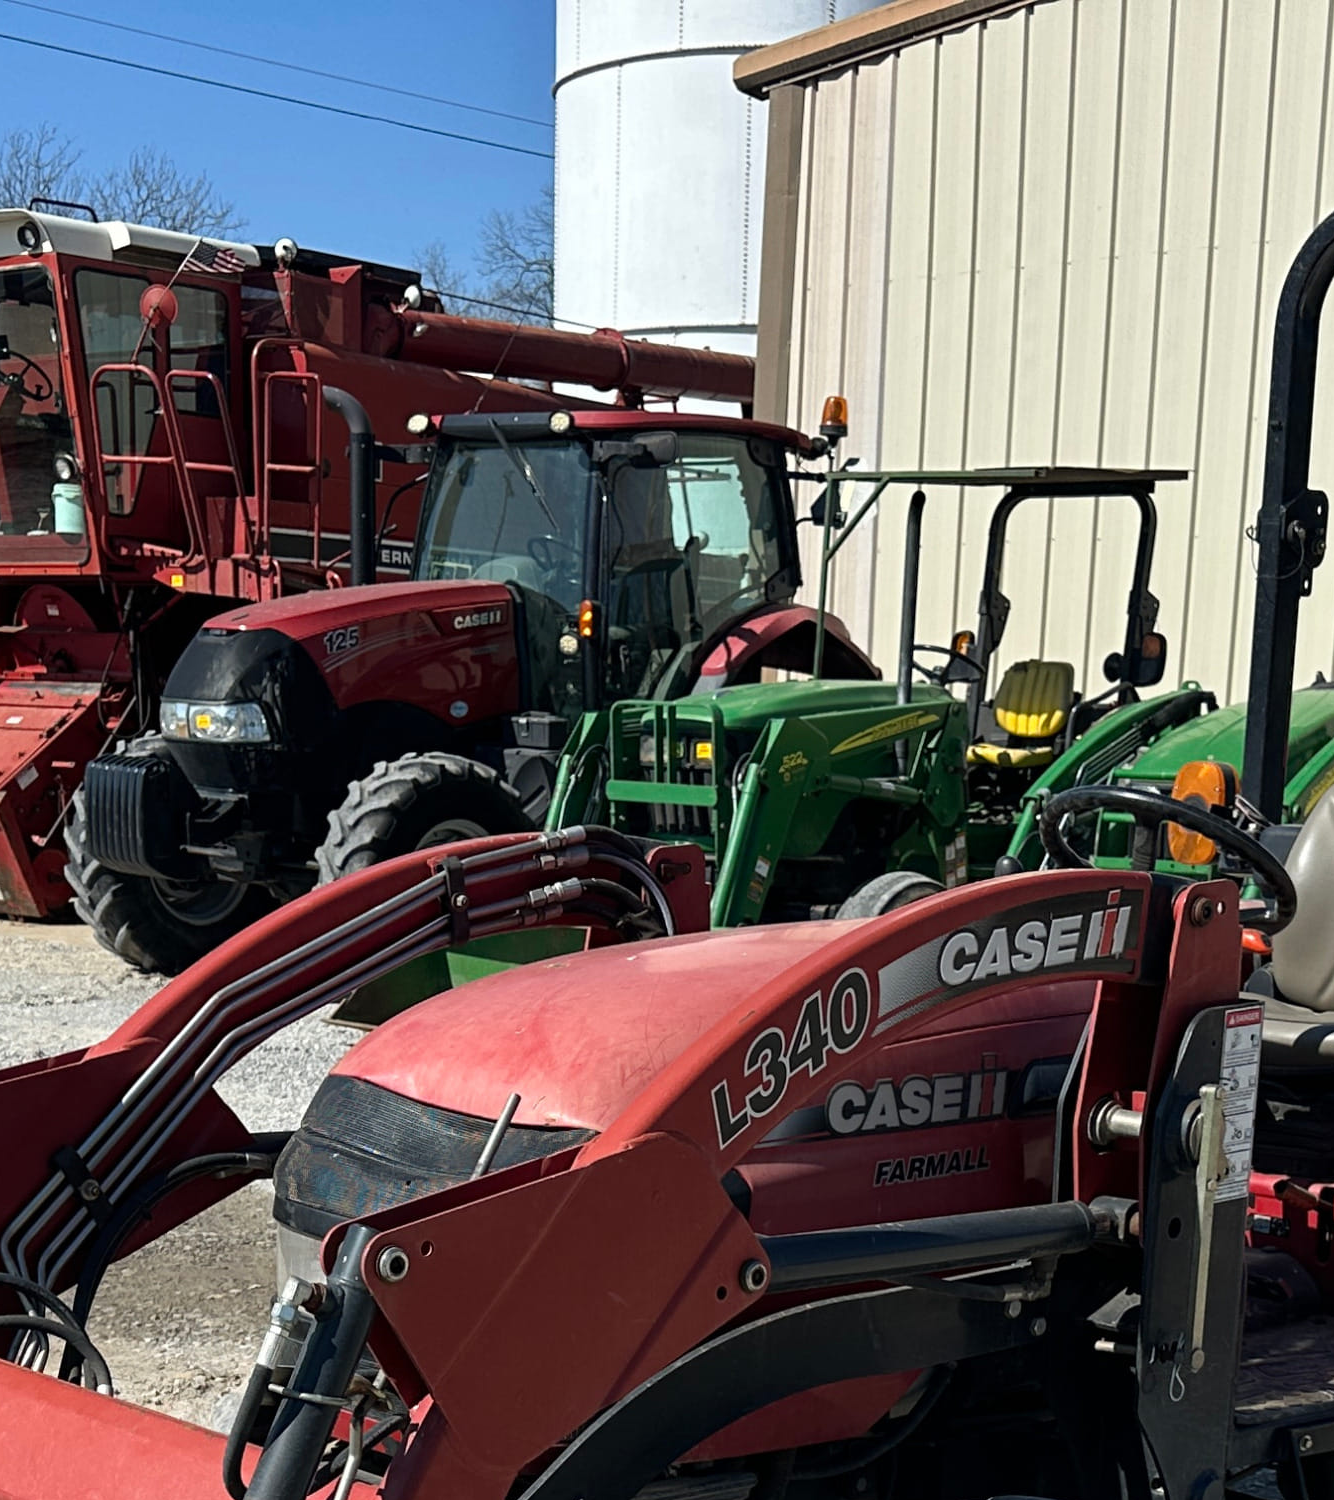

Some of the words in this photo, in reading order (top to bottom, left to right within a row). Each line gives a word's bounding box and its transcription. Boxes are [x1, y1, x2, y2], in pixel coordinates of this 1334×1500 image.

[324, 627, 359, 654] 125
[454, 613, 489, 630] CASE
[940, 914, 1083, 986] CASE
[711, 966, 871, 1151] L340
[826, 1074, 965, 1137] CASE
[874, 1146, 990, 1188] FARMALL
